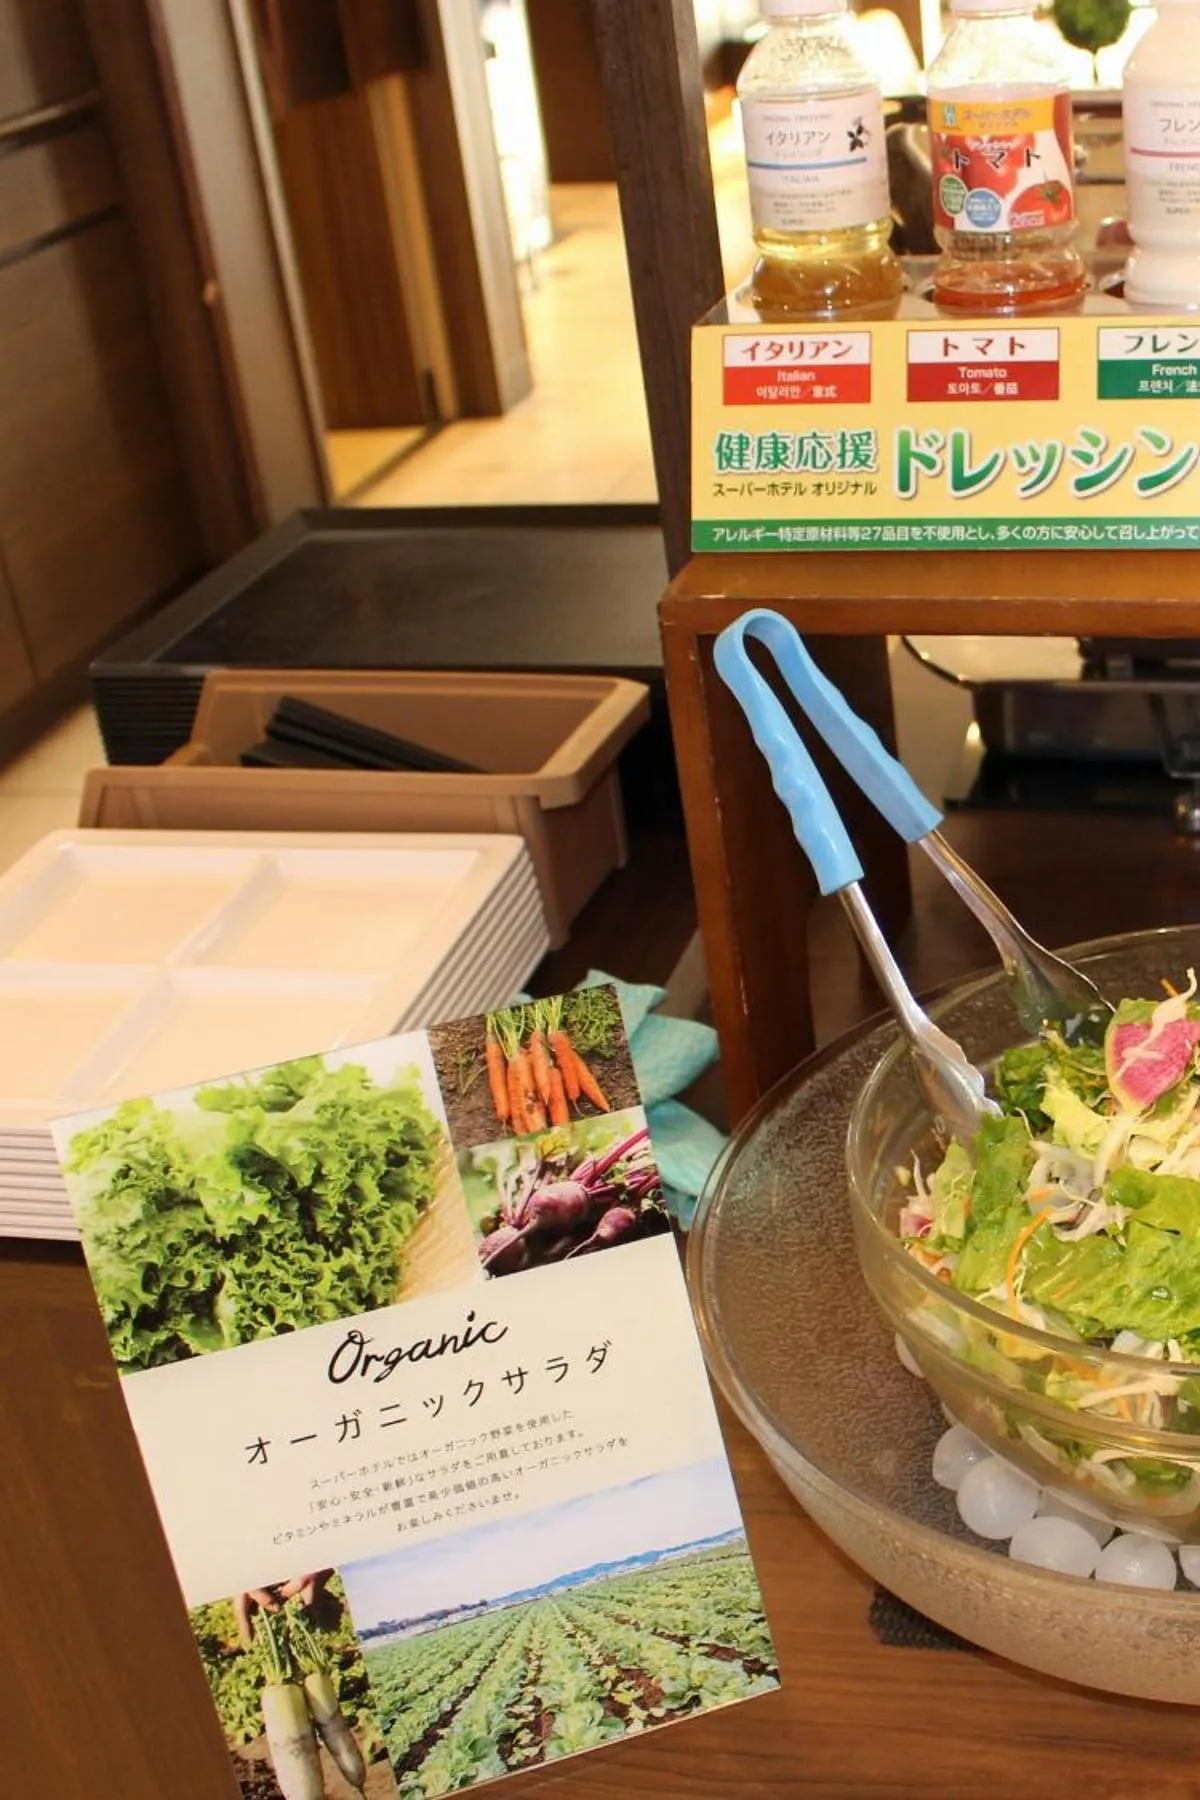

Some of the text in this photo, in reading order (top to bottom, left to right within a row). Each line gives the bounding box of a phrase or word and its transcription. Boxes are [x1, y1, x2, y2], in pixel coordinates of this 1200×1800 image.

[765, 129, 832, 146] イタリアン
[953, 147, 1041, 169] トマト
[741, 339, 853, 361] イタリアン
[943, 336, 1026, 357] トマト
[777, 369, 816, 382] Italian
[957, 366, 1008, 379] Tomato
[1151, 363, 1198, 376] French
[714, 430, 876, 473] 健康応援
[712, 481, 877, 498] スーパーホテル オリジナル
[327, 1310, 510, 1384] Organic
[244, 1339, 615, 1466] オーガニックサラダ
